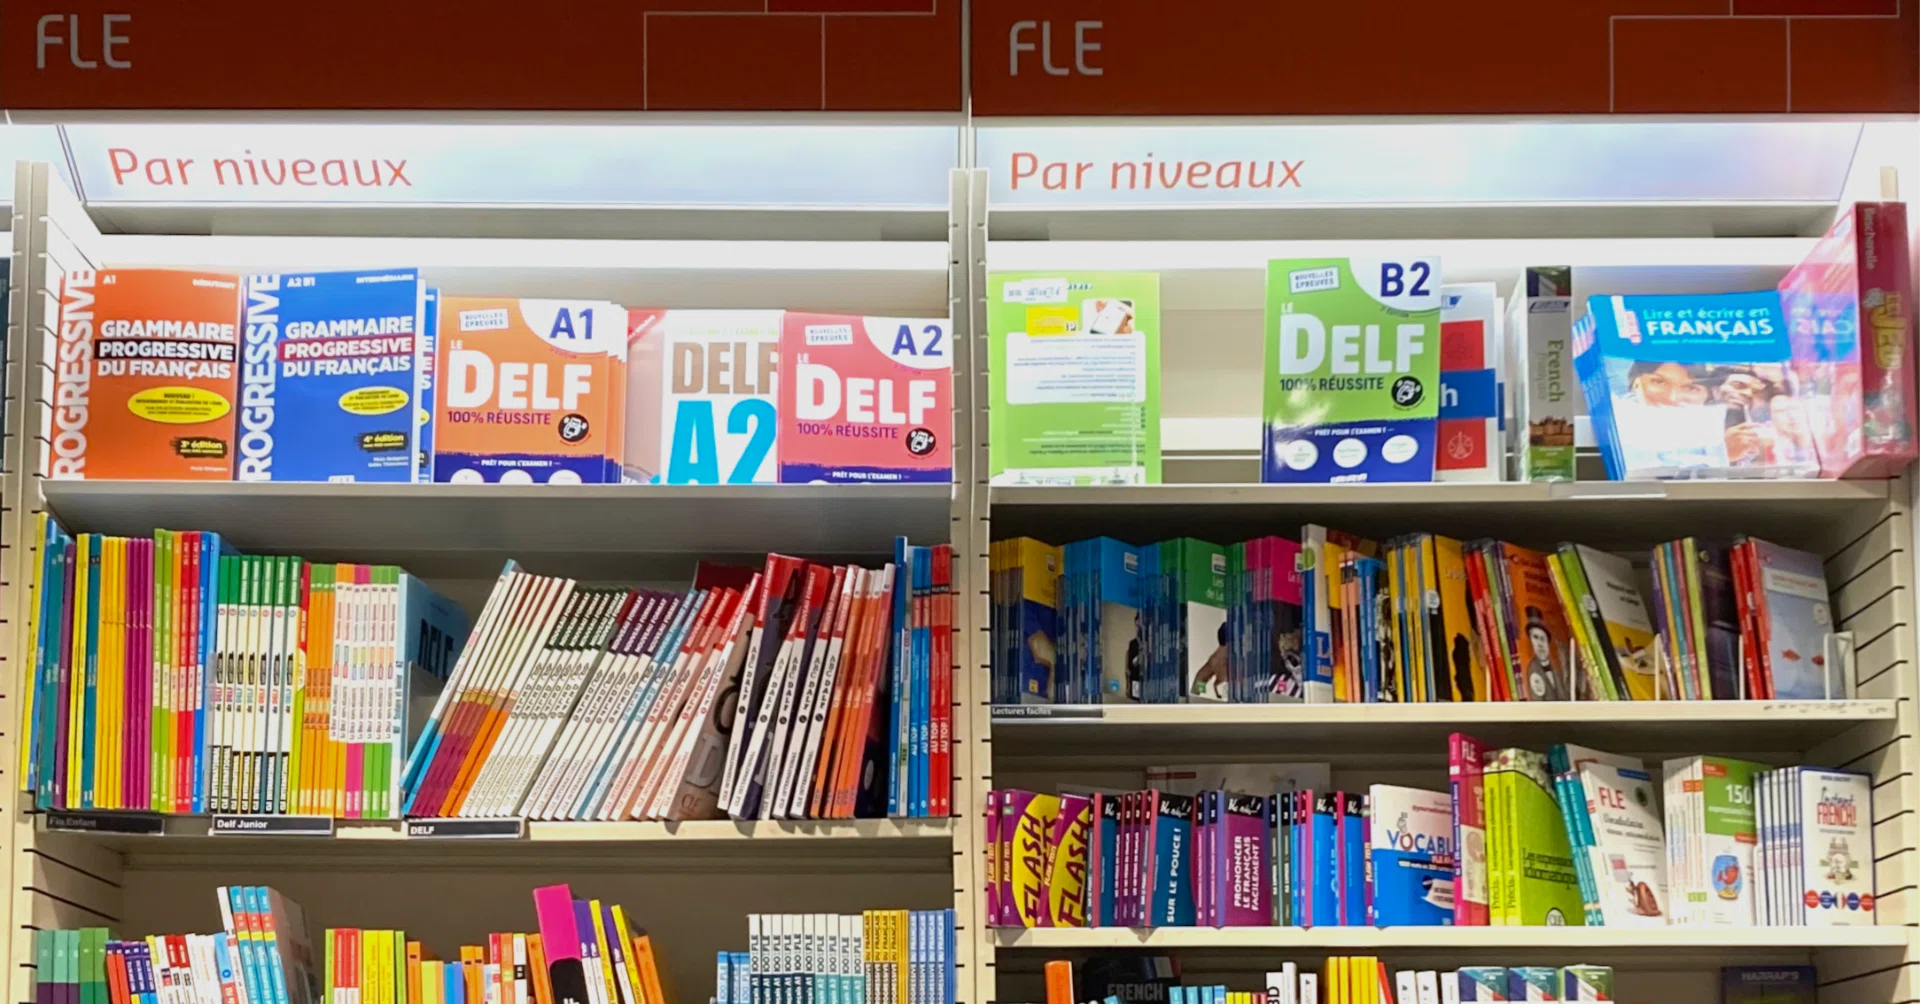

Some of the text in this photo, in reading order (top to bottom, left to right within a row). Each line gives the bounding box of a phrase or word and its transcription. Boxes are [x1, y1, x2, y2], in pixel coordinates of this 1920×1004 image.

[36, 13, 132, 69] FLE
[1009, 20, 1104, 77] FLE
[107, 147, 412, 187] Par niveaux
[1011, 152, 1305, 190] Par niveaux
[1295, 278, 1335, 289] ÉPREUVES
[1380, 262, 1430, 297] B2
[549, 307, 593, 340] A1
[1643, 307, 1770, 320] Lire et écrire en
[100, 320, 234, 341] GRAMMAIRE
[285, 316, 413, 339] GRAMMAIRE
[1646, 318, 1774, 342] FRANÇAIS
[99, 341, 234, 360] PROGRESSIVE
[284, 337, 412, 359] PROGRESSIVE
[450, 339, 463, 350] LE
[892, 324, 943, 356] A2
[1279, 313, 1425, 375] DELF
[98, 360, 231, 380] DU FRANÇAIS
[283, 356, 411, 377] DU FRANÇAIS
[672, 342, 778, 394] DELF
[1548, 340, 1565, 403] French
[446, 349, 592, 410] DELF
[1280, 375, 1384, 391] 100% RÉUSSITE
[796, 363, 936, 425] DELF
[448, 409, 551, 425] 100% RÉUSSITE
[374, 434, 404, 443] édition
[667, 398, 777, 484] A2
[797, 423, 898, 439] 100% RÉUSSITE
[191, 440, 223, 449] édition
[992, 707, 1051, 716] Lectures faciles
[931, 722, 939, 739] TOP
[940, 722, 948, 739] TOP
[1598, 786, 1627, 810] FLE
[217, 820, 268, 829] Delf Junior
[410, 826, 435, 835] DELF
[1022, 813, 1043, 920] FLASH
[1171, 834, 1181, 876] POUCE
[1058, 822, 1089, 927] FLASH
[1234, 836, 1242, 907] PRONONCER
[1243, 836, 1252, 908] LE FRANÇAIS
[1252, 843, 1260, 911] FACILEMENT
[1168, 880, 1177, 894] LE
[1167, 899, 1176, 923] SUR
[1107, 983, 1164, 1001] FRENCH
